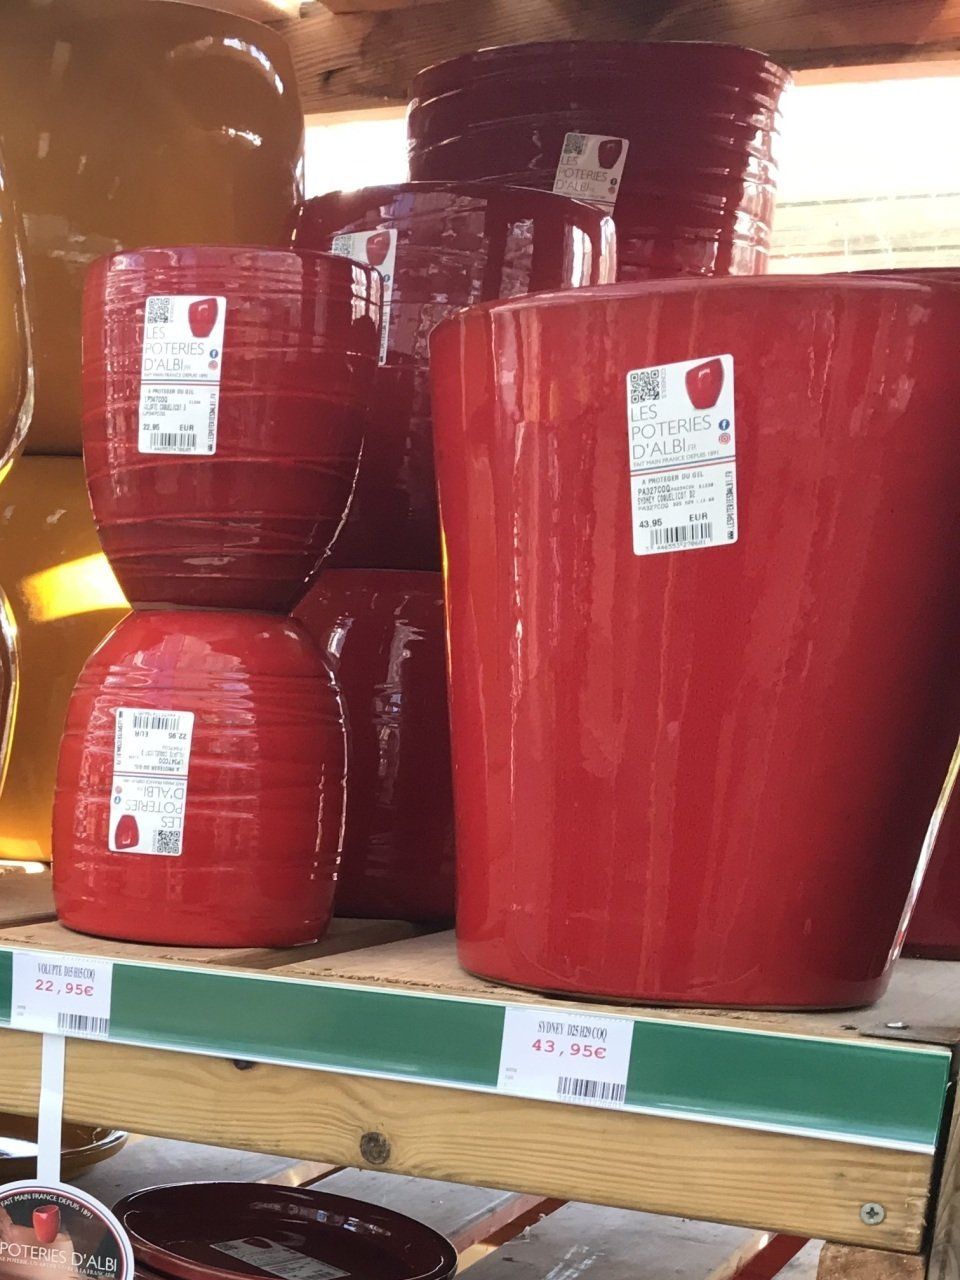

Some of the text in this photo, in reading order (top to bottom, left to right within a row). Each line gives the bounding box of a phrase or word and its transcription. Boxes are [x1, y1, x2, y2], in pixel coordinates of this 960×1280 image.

[560, 155, 578, 166] LES
[558, 167, 608, 182] POTERIES
[145, 326, 166, 340] LES
[144, 342, 205, 356] POTERIES
[631, 403, 658, 423] LES
[179, 424, 194, 432] EUR
[632, 415, 712, 442] POTERIES
[639, 512, 708, 529] 43.95 EUR
[125, 799, 183, 813] POTERIES
[161, 815, 182, 829] LES
[38, 963, 62, 976] VOLUPTE
[35, 979, 94, 996] 22,95€
[538, 1021, 564, 1035] SYDNEY
[531, 1038, 607, 1060] 43,95€
[0, 1196, 13, 1207] FAIT
[14, 1193, 31, 1202] MAIN
[32, 1193, 57, 1202] FRANCE
[58, 1196, 79, 1211] DEPUIS
[0, 1241, 67, 1264] POTERIES
[71, 1251, 117, 1272] D'ALBI
